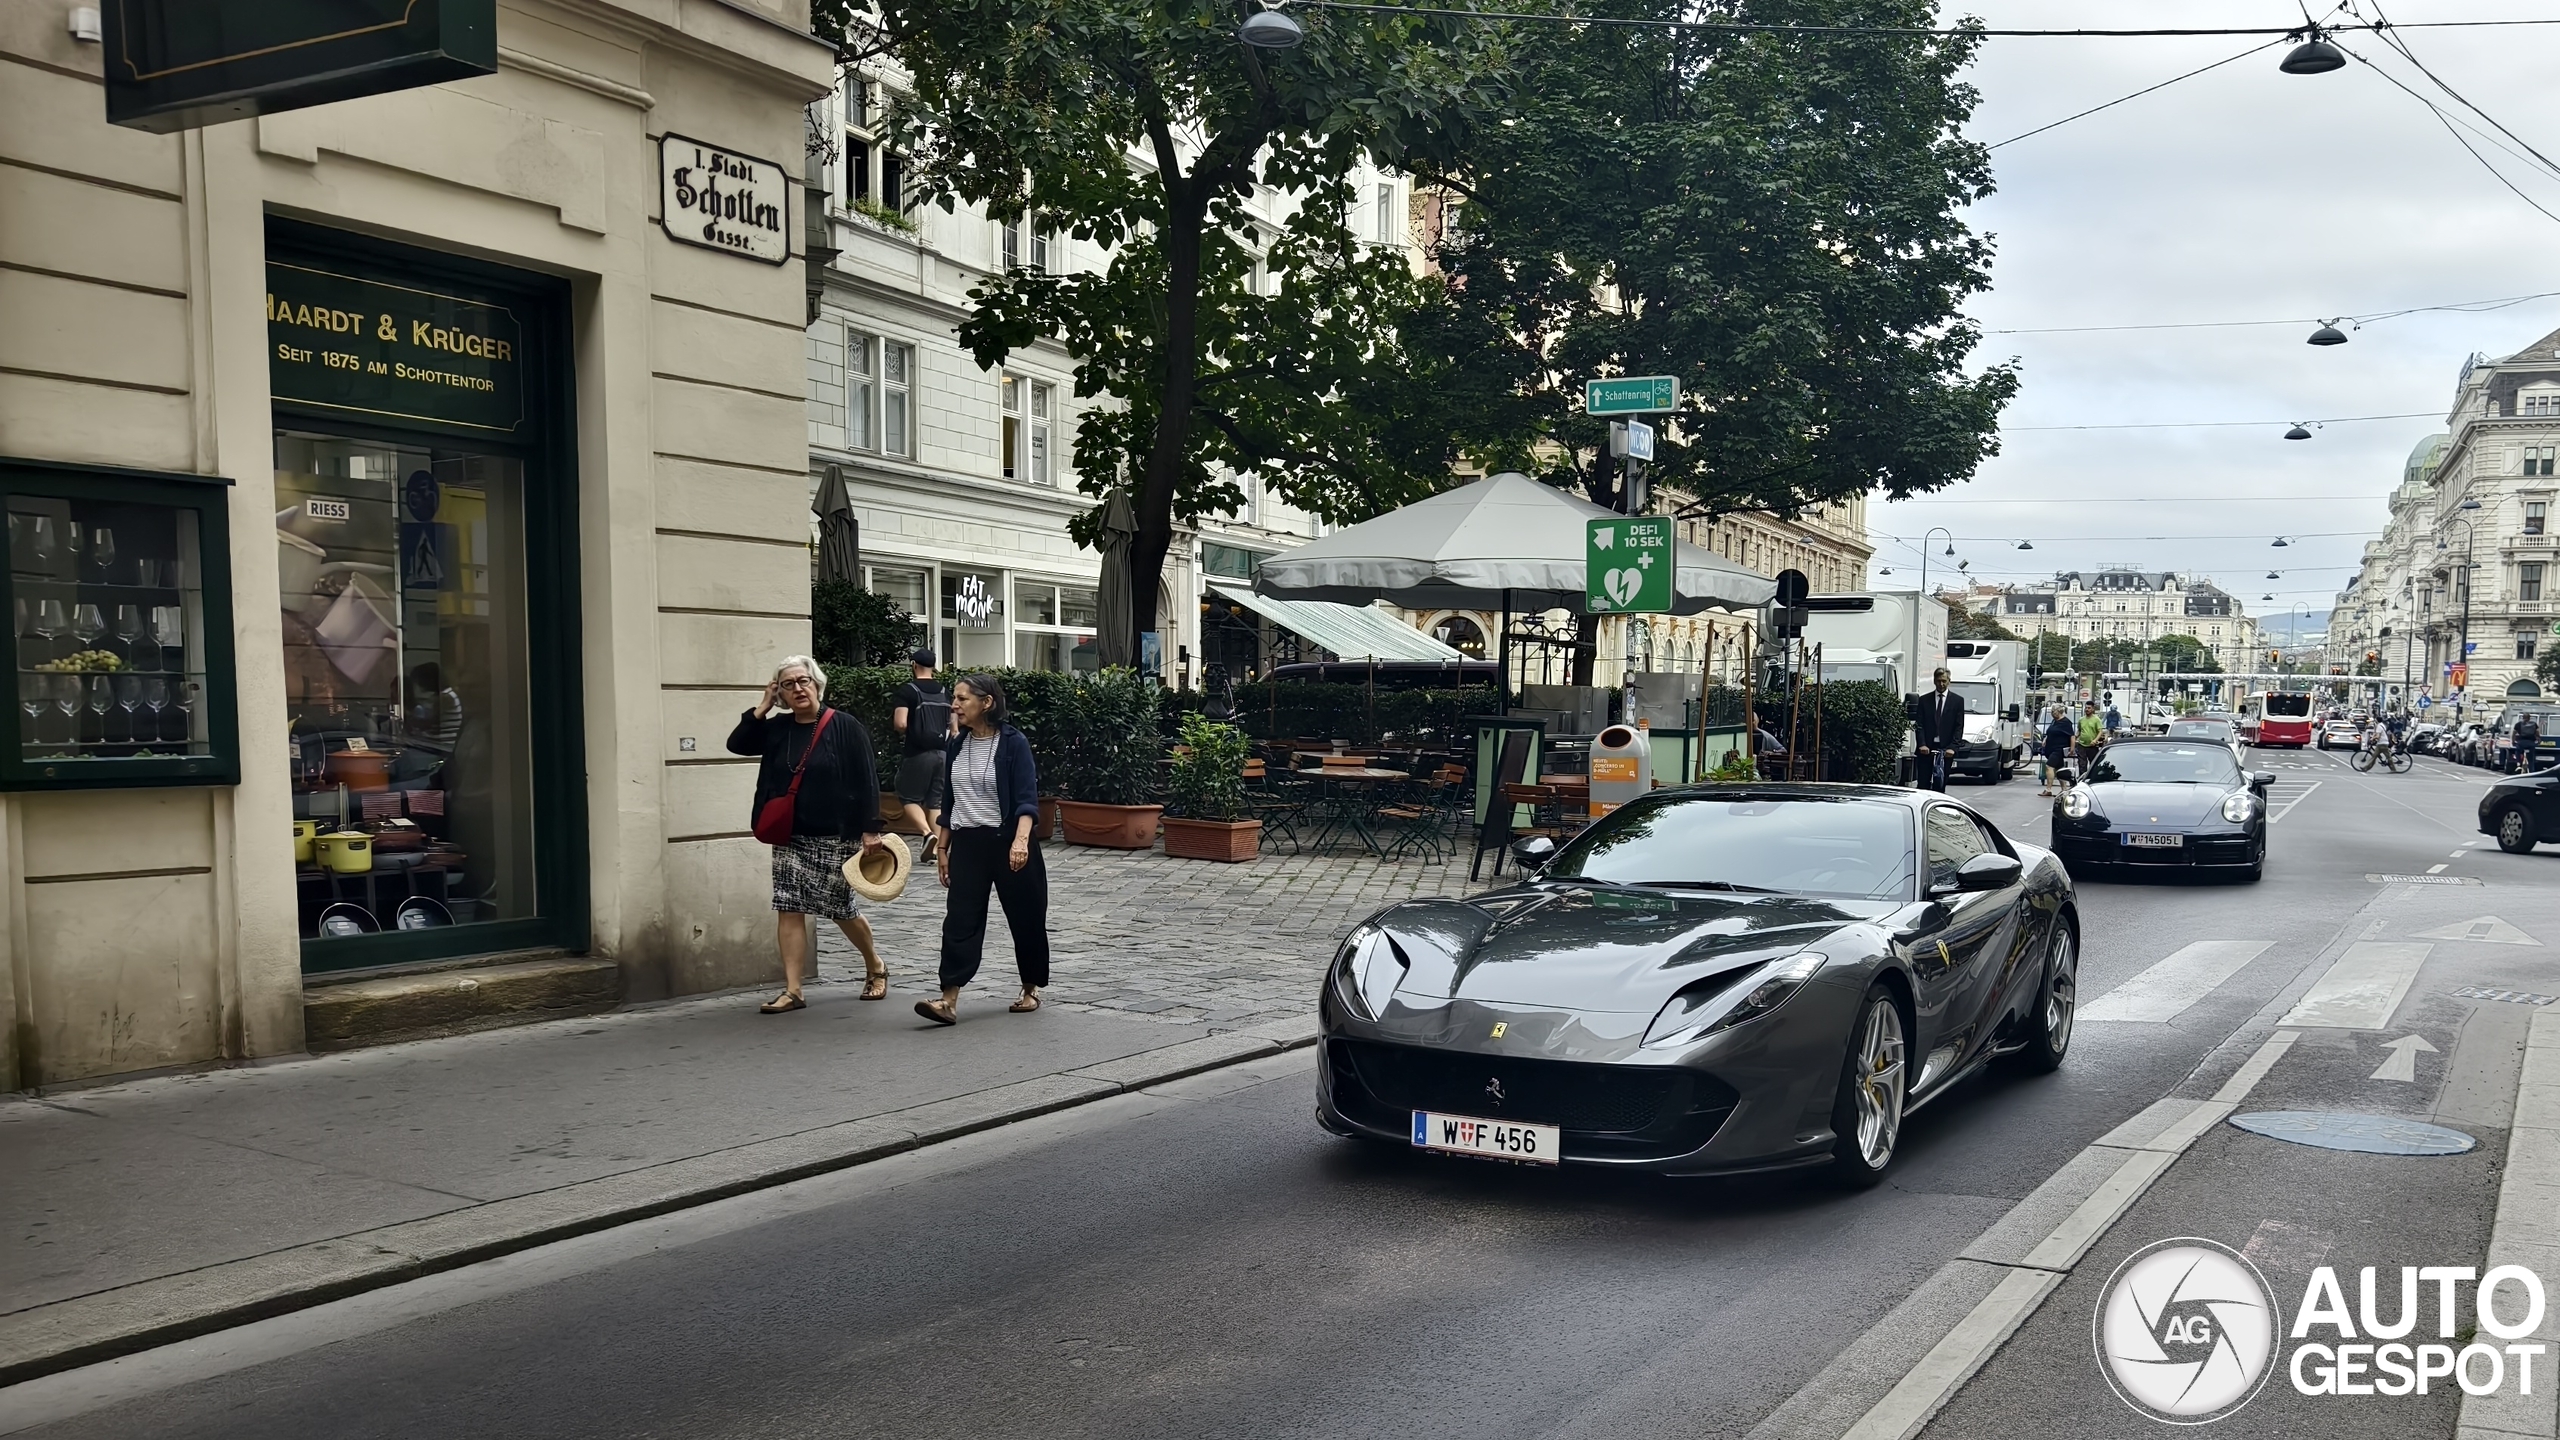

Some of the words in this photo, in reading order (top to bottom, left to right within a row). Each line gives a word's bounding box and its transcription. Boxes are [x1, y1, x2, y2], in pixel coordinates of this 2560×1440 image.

[708, 152, 758, 184] Stadt.
[673, 166, 780, 233] Schotten
[703, 222, 755, 251] Gasse.
[377, 314, 398, 342] &
[413, 319, 512, 362] KRÜGER
[278, 343, 313, 363] SEIT
[321, 351, 360, 371] 1875
[367, 361, 388, 375] AM
[395, 362, 494, 392] SCHOTTENTOR
[1605, 390, 1651, 401] Schottenring
[1630, 428, 1640, 449] WC
[311, 502, 345, 517] RIESS
[1624, 537, 1637, 547] 10
[1640, 536, 1664, 547] SEK
[1630, 525, 1657, 535] DEFI
[963, 574, 985, 600] FAT
[956, 593, 994, 619] MONK
[2130, 834, 2137, 844] W
[1417, 1131, 1424, 1140] A
[1443, 1119, 1459, 1145] W
[1475, 1124, 1488, 1148] F
[1494, 1125, 1536, 1153] 456
